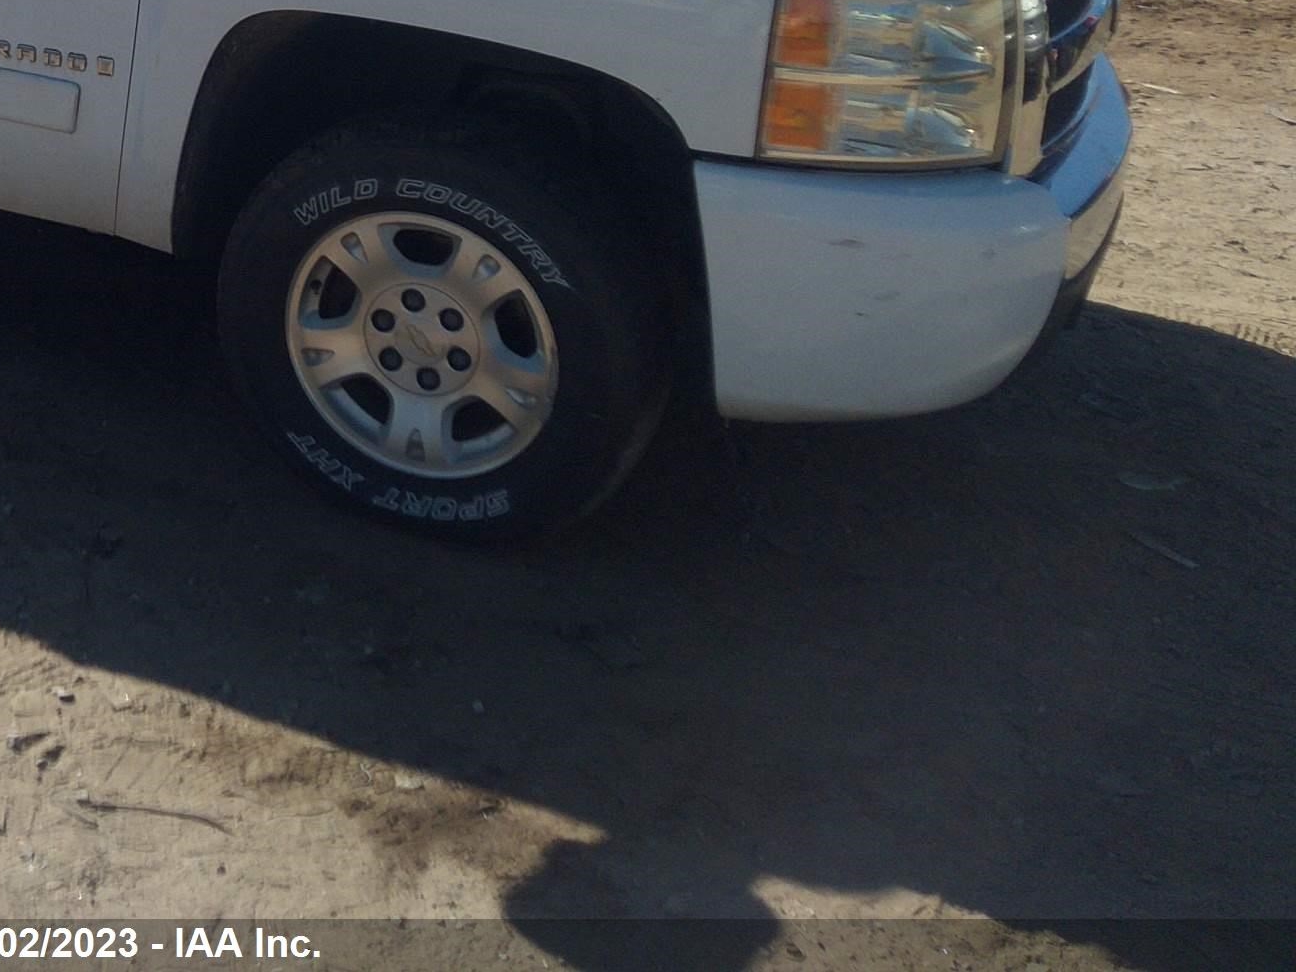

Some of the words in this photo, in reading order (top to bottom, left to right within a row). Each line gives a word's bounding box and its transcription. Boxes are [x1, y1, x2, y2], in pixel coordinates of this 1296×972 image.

[293, 178, 378, 226] WILD
[395, 178, 574, 290] COUNTRY
[286, 431, 365, 491] XHT
[372, 487, 510, 521] SPORT
